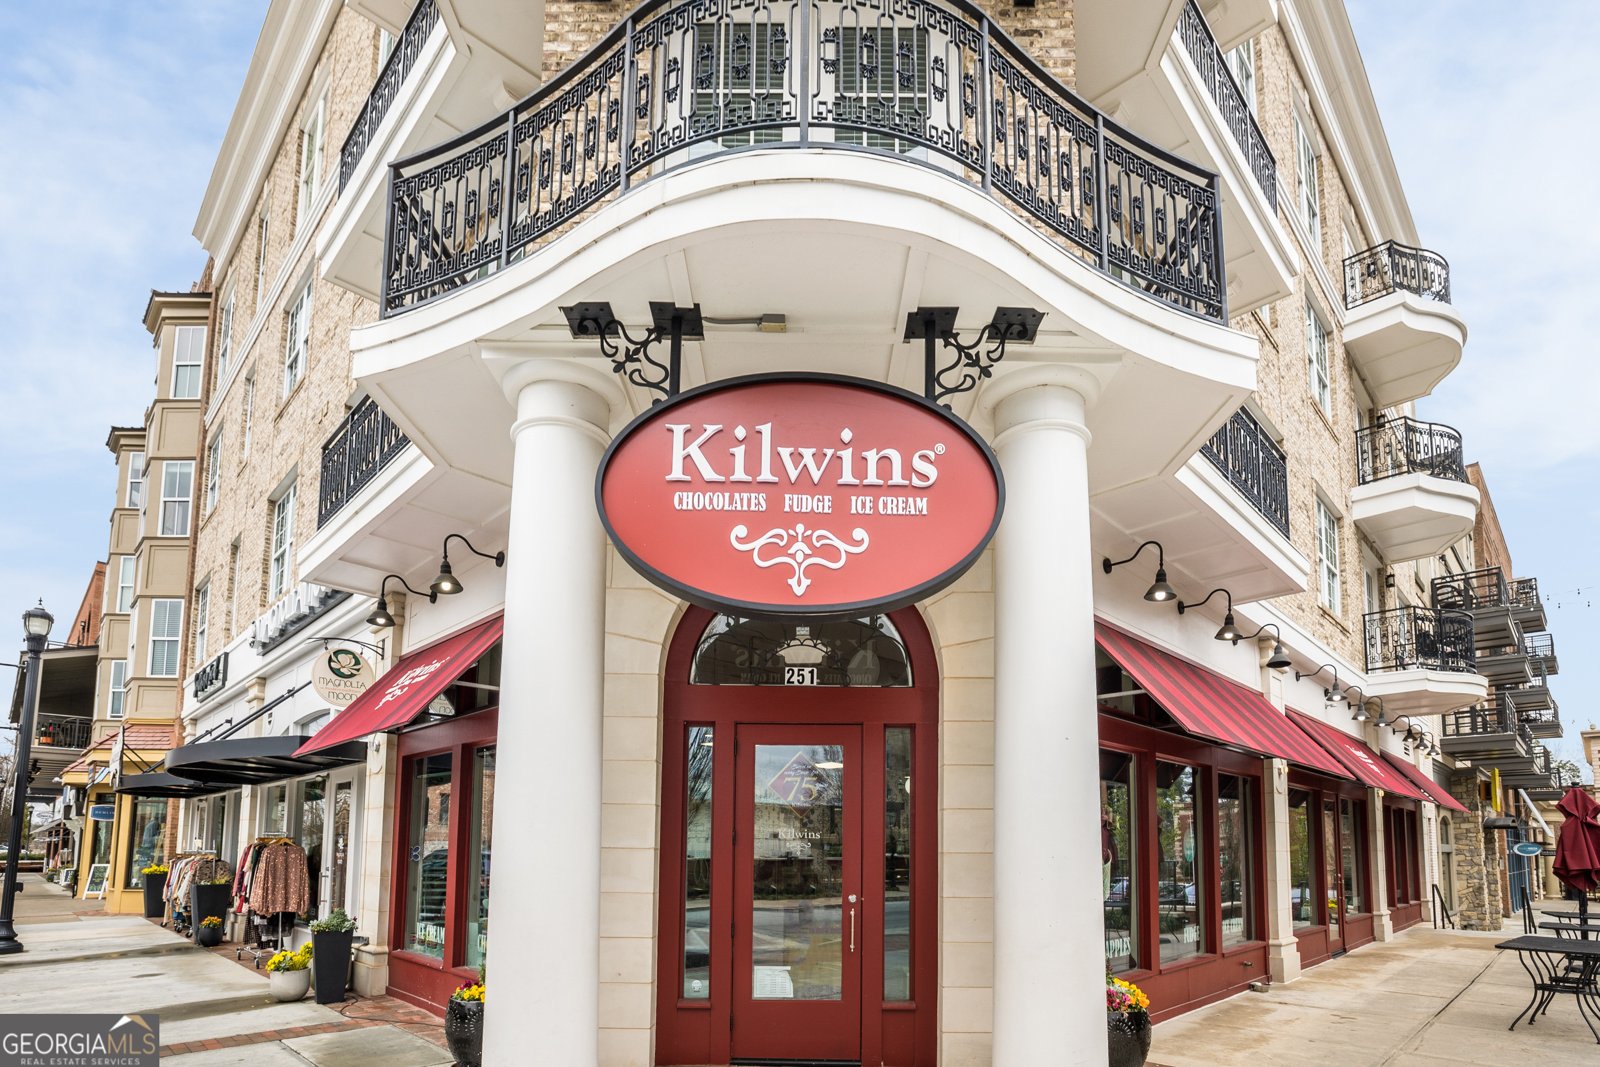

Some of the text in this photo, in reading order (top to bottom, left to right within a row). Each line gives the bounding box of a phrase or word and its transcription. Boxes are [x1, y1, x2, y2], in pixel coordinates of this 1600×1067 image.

[673, 491, 928, 515] CHOCOLATES FUDGE ICE CREAM
[318, 676, 367, 690] MAGNOLIA
[786, 668, 815, 685] 251
[784, 776, 817, 801] 75
